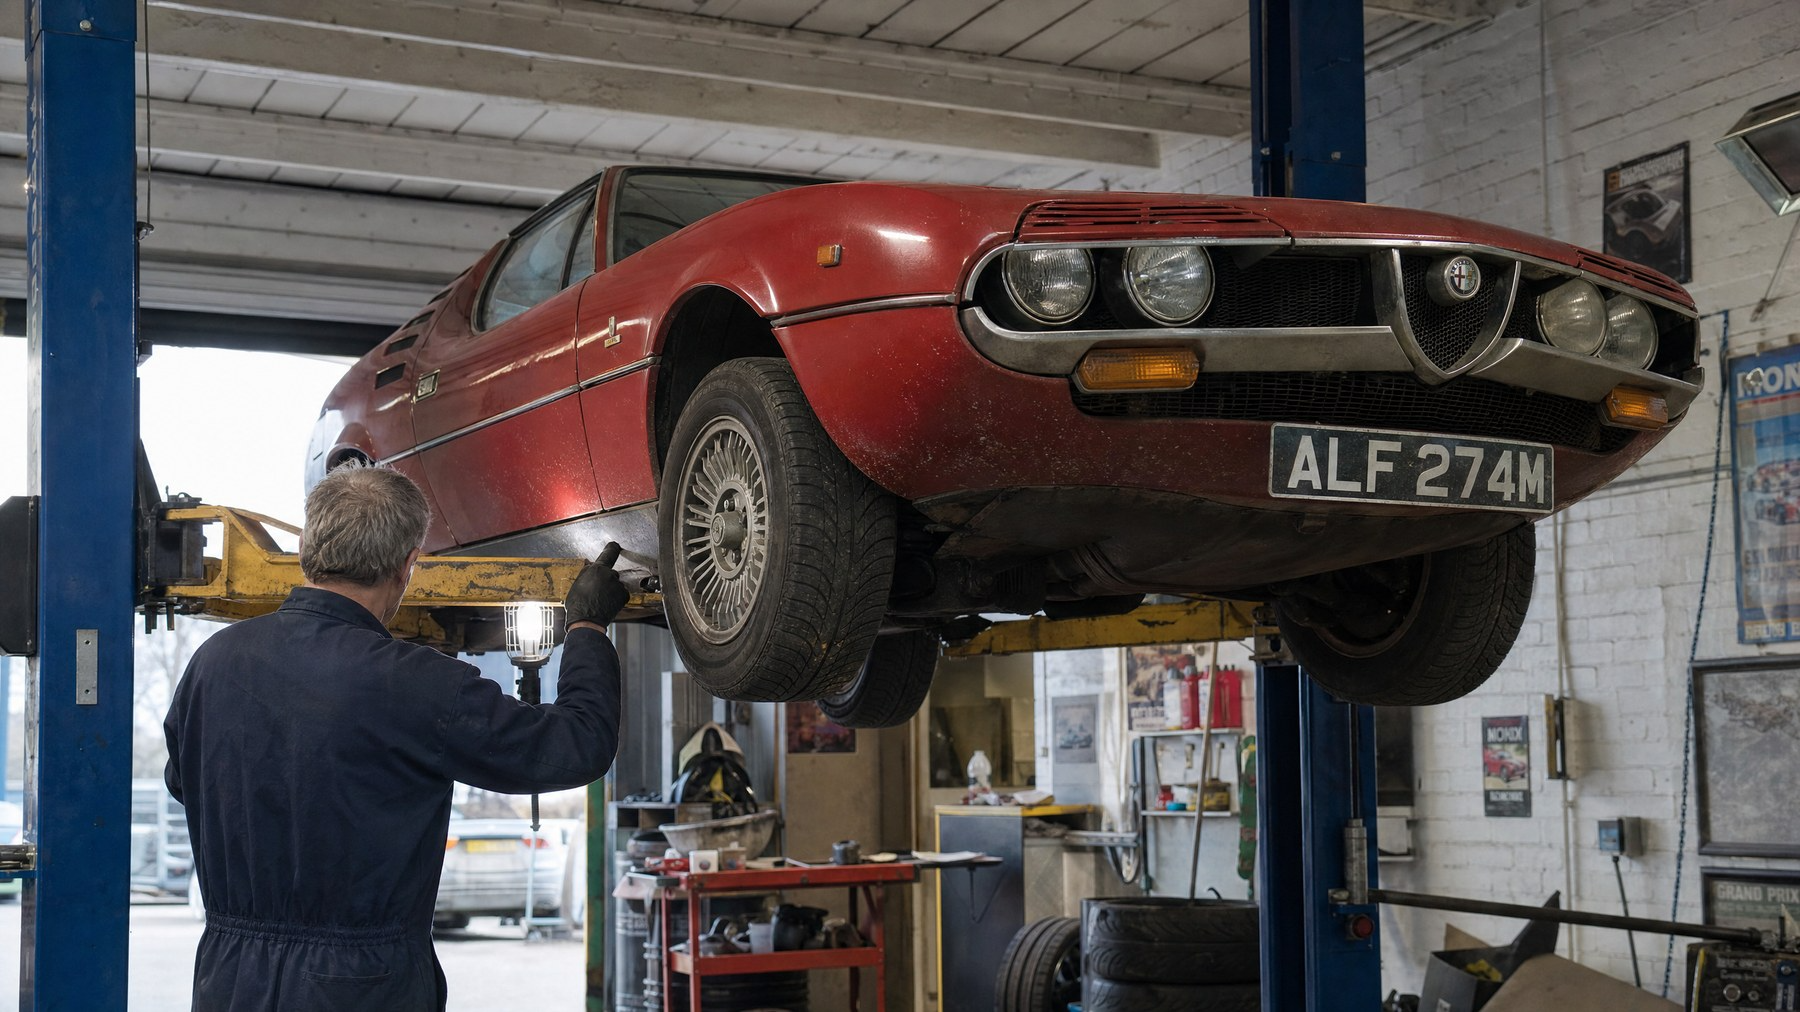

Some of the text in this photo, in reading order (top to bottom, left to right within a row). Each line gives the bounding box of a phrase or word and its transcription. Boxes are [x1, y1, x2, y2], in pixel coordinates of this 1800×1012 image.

[1287, 435, 1544, 504] ALF 274M
[1717, 883, 1800, 904] GRAND PRIX
